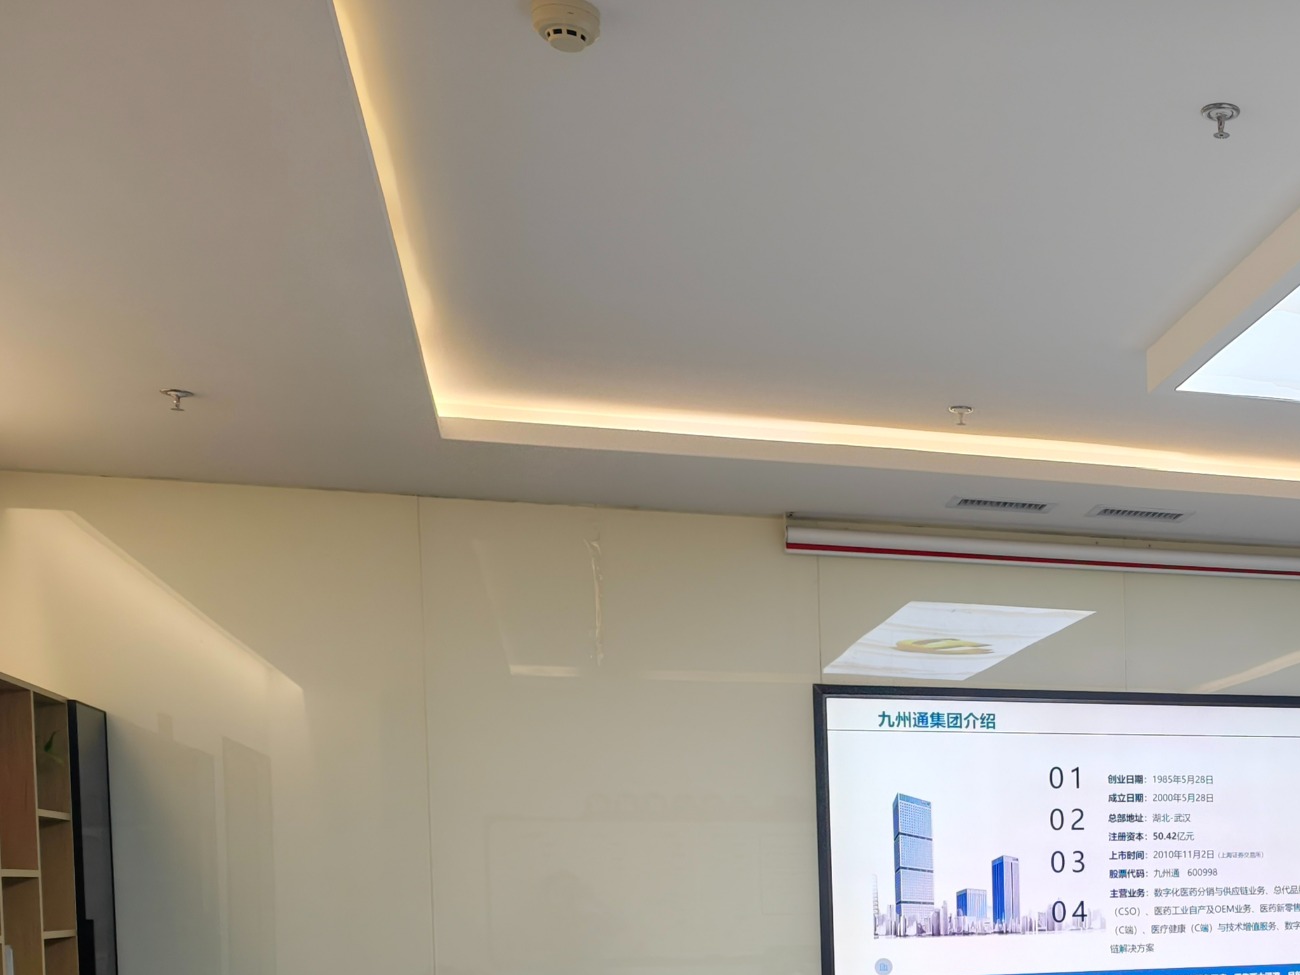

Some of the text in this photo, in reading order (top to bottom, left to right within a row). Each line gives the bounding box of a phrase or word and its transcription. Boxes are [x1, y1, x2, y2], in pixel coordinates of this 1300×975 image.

[878, 710, 996, 731] 九州通集团介绍
[1048, 766, 1084, 789] 01
[1049, 808, 1086, 831] 02
[1050, 850, 1086, 874] 03
[1187, 868, 1218, 877] 600998
[1051, 900, 1088, 924] 04
[1110, 943, 1155, 954] 链解决方案
